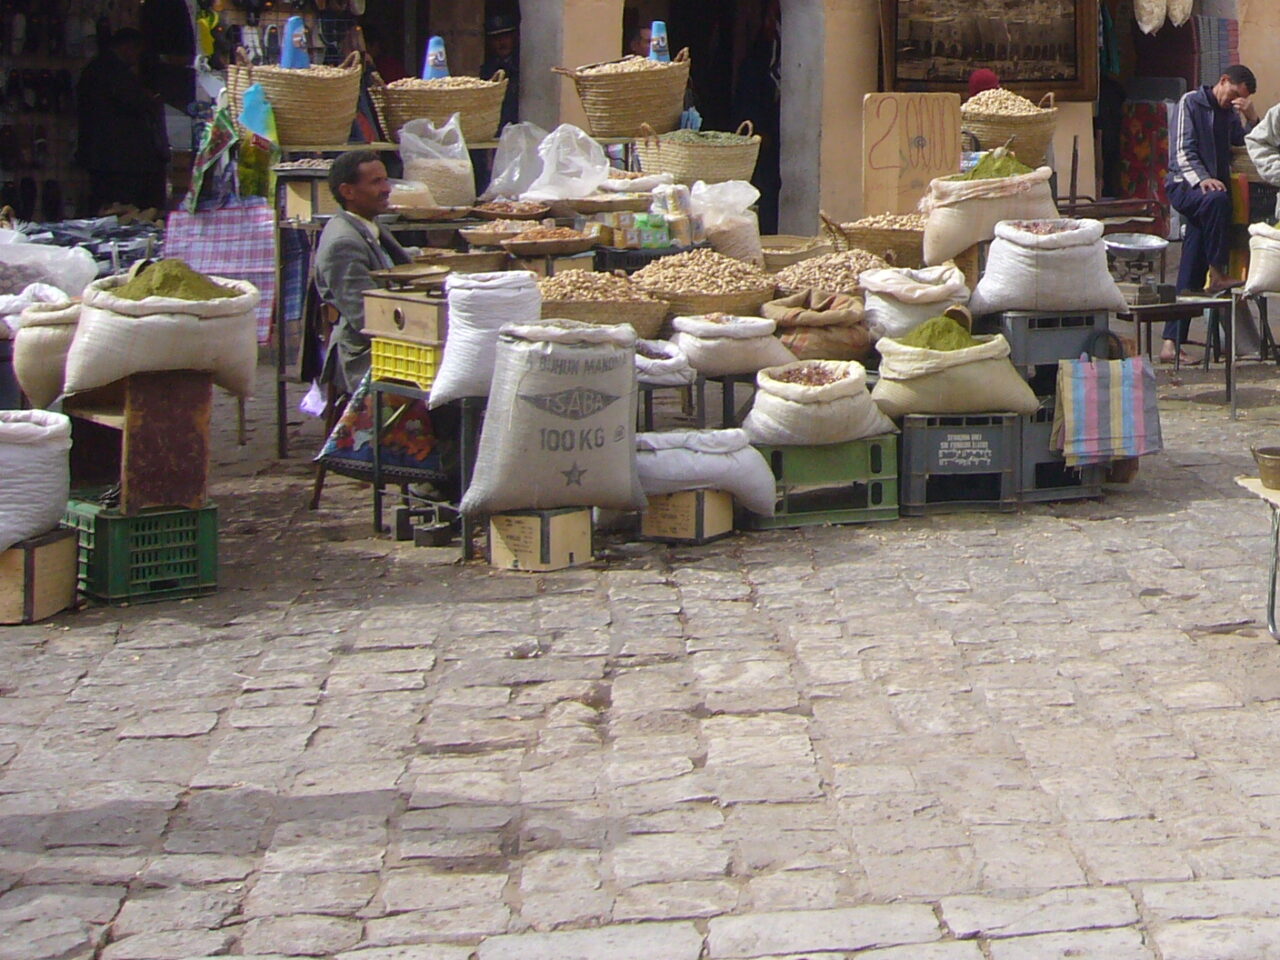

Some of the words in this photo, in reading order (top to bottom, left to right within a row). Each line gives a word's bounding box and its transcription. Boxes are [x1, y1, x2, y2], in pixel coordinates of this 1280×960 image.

[545, 391, 604, 416] TSABA
[540, 428, 576, 451] 100
[580, 427, 605, 450] KG
